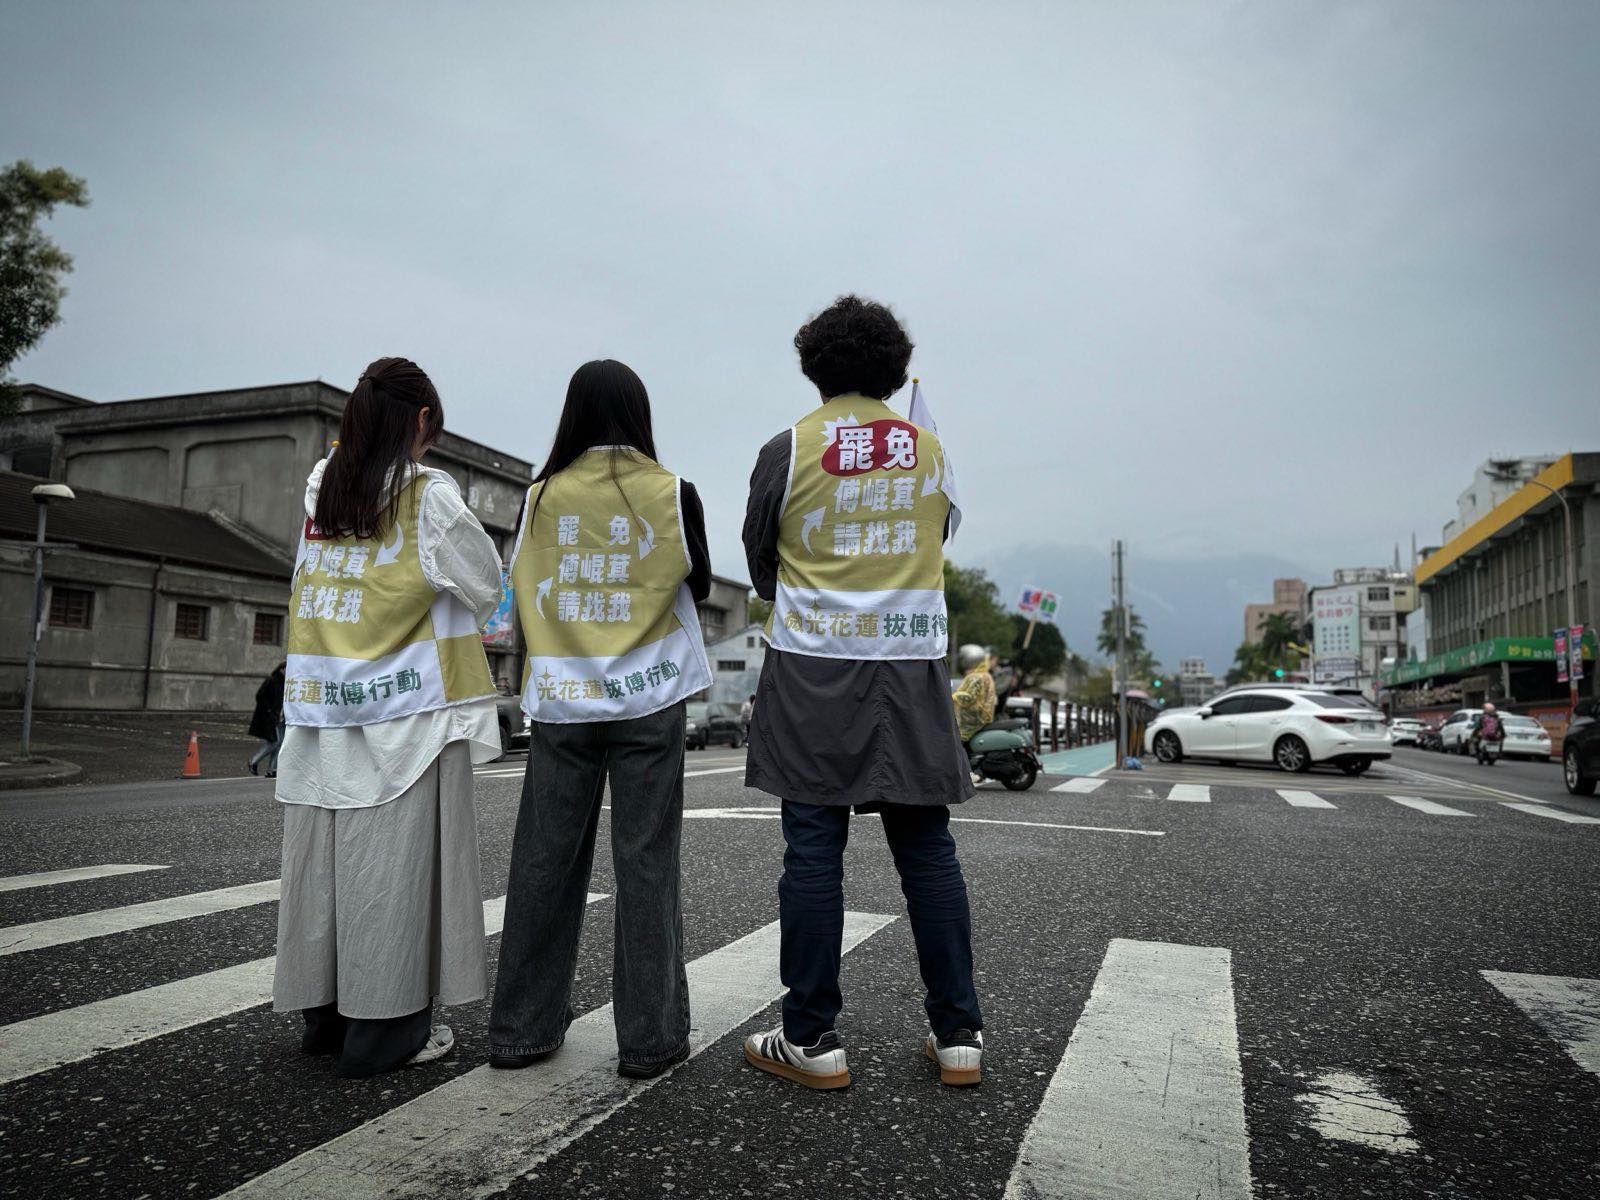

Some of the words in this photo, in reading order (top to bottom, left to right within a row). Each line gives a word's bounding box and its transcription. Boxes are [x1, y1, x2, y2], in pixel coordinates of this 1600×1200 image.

[838, 426, 915, 471] 罷免
[832, 520, 917, 556] 請找我
[297, 584, 363, 624] 請找我
[558, 591, 631, 623] 請找我
